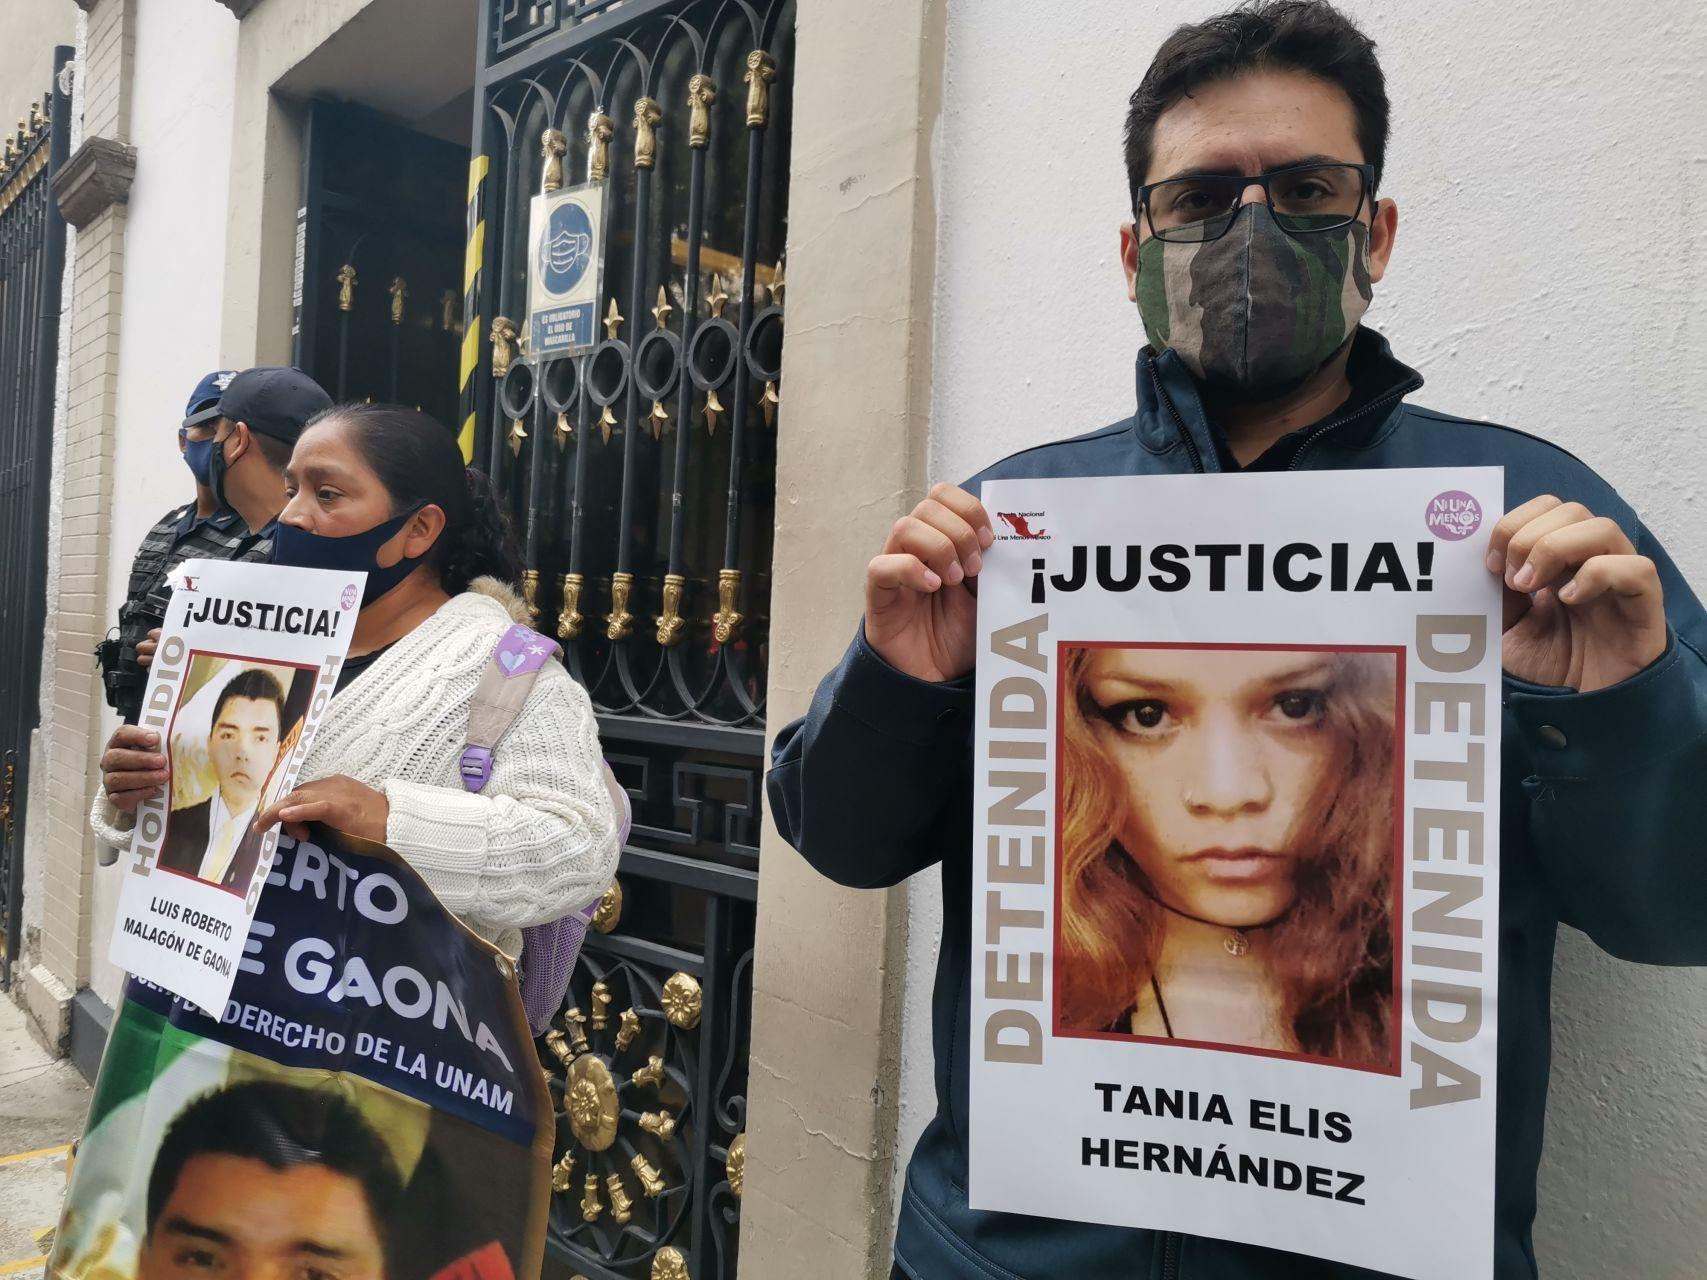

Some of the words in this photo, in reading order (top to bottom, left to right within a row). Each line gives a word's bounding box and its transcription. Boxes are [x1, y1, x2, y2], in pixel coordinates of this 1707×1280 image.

[544, 333, 575, 346] MASCARILLA
[549, 309, 580, 323] OBLIGATORIO
[565, 322, 573, 331] DE
[1429, 510, 1480, 526] MENOS
[1031, 541, 1434, 603] ¡JUSTICIA!
[183, 597, 340, 638] ¡JUSTICIA!
[984, 613, 1048, 1065] DETENIDA
[1410, 614, 1487, 1110] DETENIDA
[123, 917, 185, 953] MALAGÓN
[185, 941, 202, 961] DE
[203, 949, 232, 979] GAONA
[150, 896, 180, 920] LUIS
[181, 907, 232, 941] ROBERTO
[284, 937, 515, 1073] GAONA
[221, 999, 346, 1055] DERECHO
[355, 1032, 392, 1064] DE
[395, 1045, 427, 1080] LA
[435, 1061, 514, 1115] UNAM
[1094, 1082, 1233, 1126] TANIA
[1249, 1098, 1353, 1144] ELIS
[1081, 1137, 1366, 1206] HERNÁNDEZ
